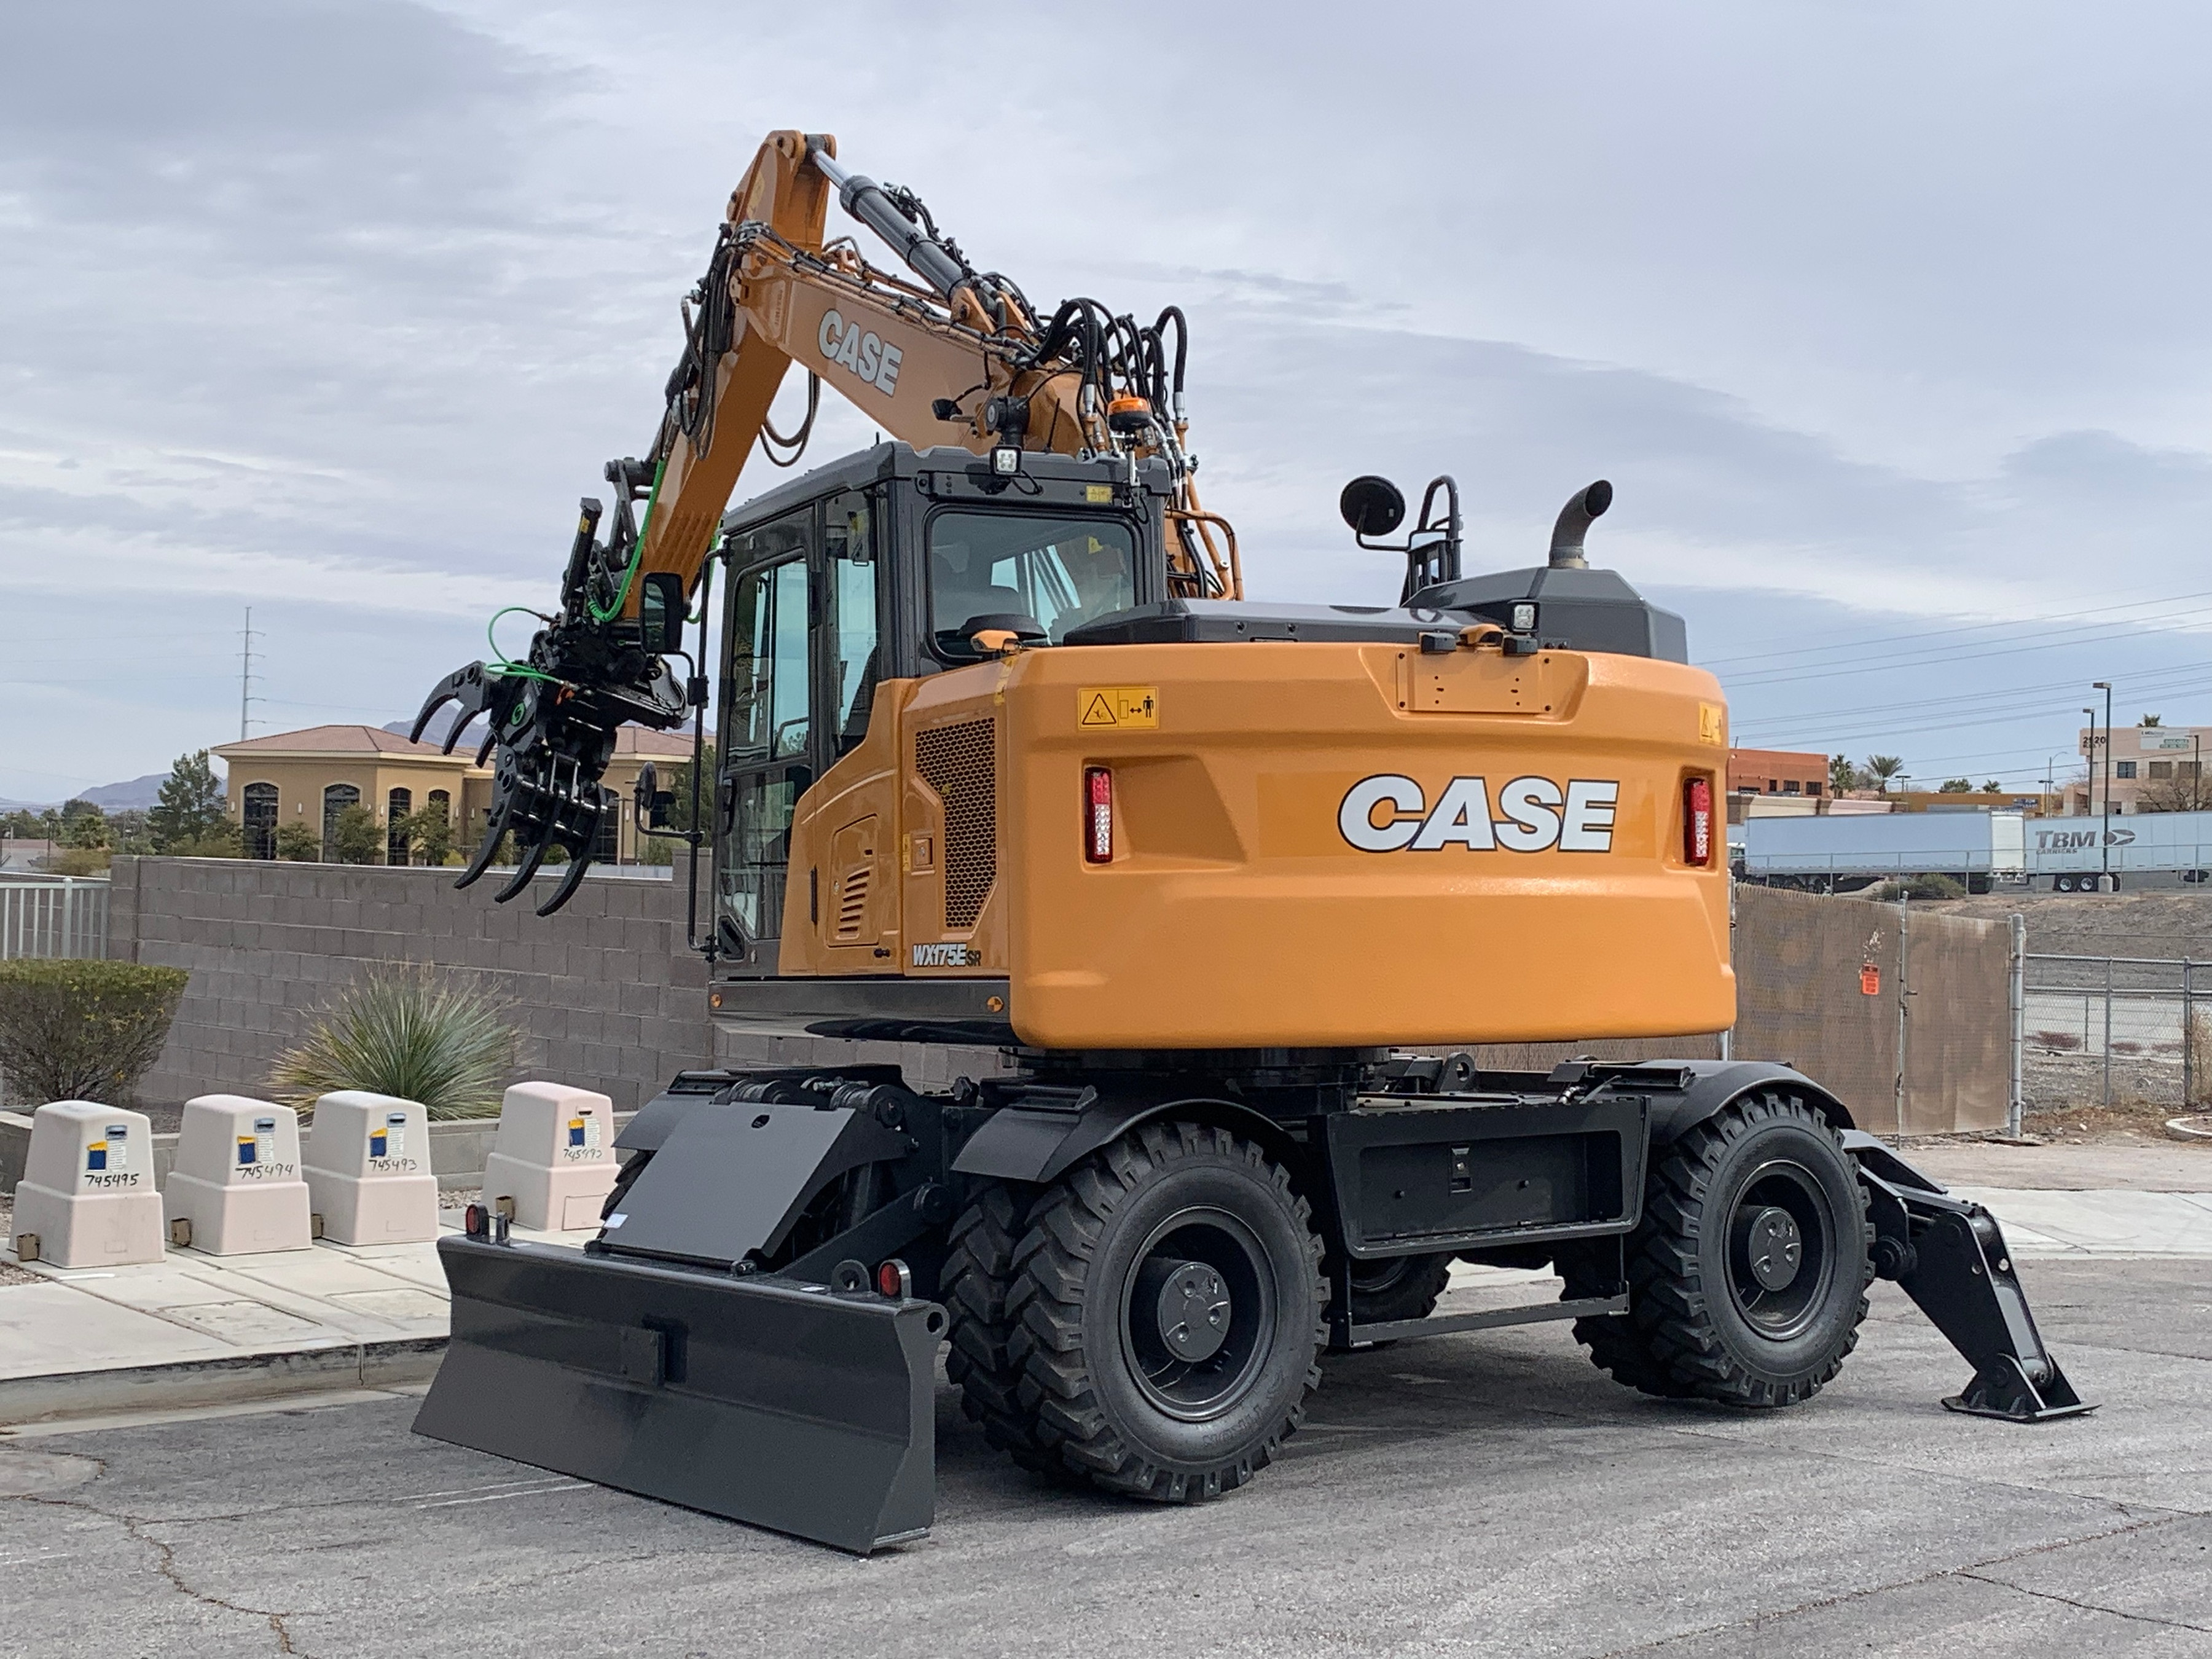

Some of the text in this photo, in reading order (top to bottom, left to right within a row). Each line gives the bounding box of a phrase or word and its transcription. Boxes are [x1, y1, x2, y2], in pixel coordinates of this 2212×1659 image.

[818, 309, 904, 398] CASE
[1338, 774, 1620, 853] CASE
[2036, 830, 2096, 848] TBM
[235, 1163, 294, 1179] 745494
[369, 1158, 417, 1171] 745493
[84, 1173, 139, 1188] 745495
